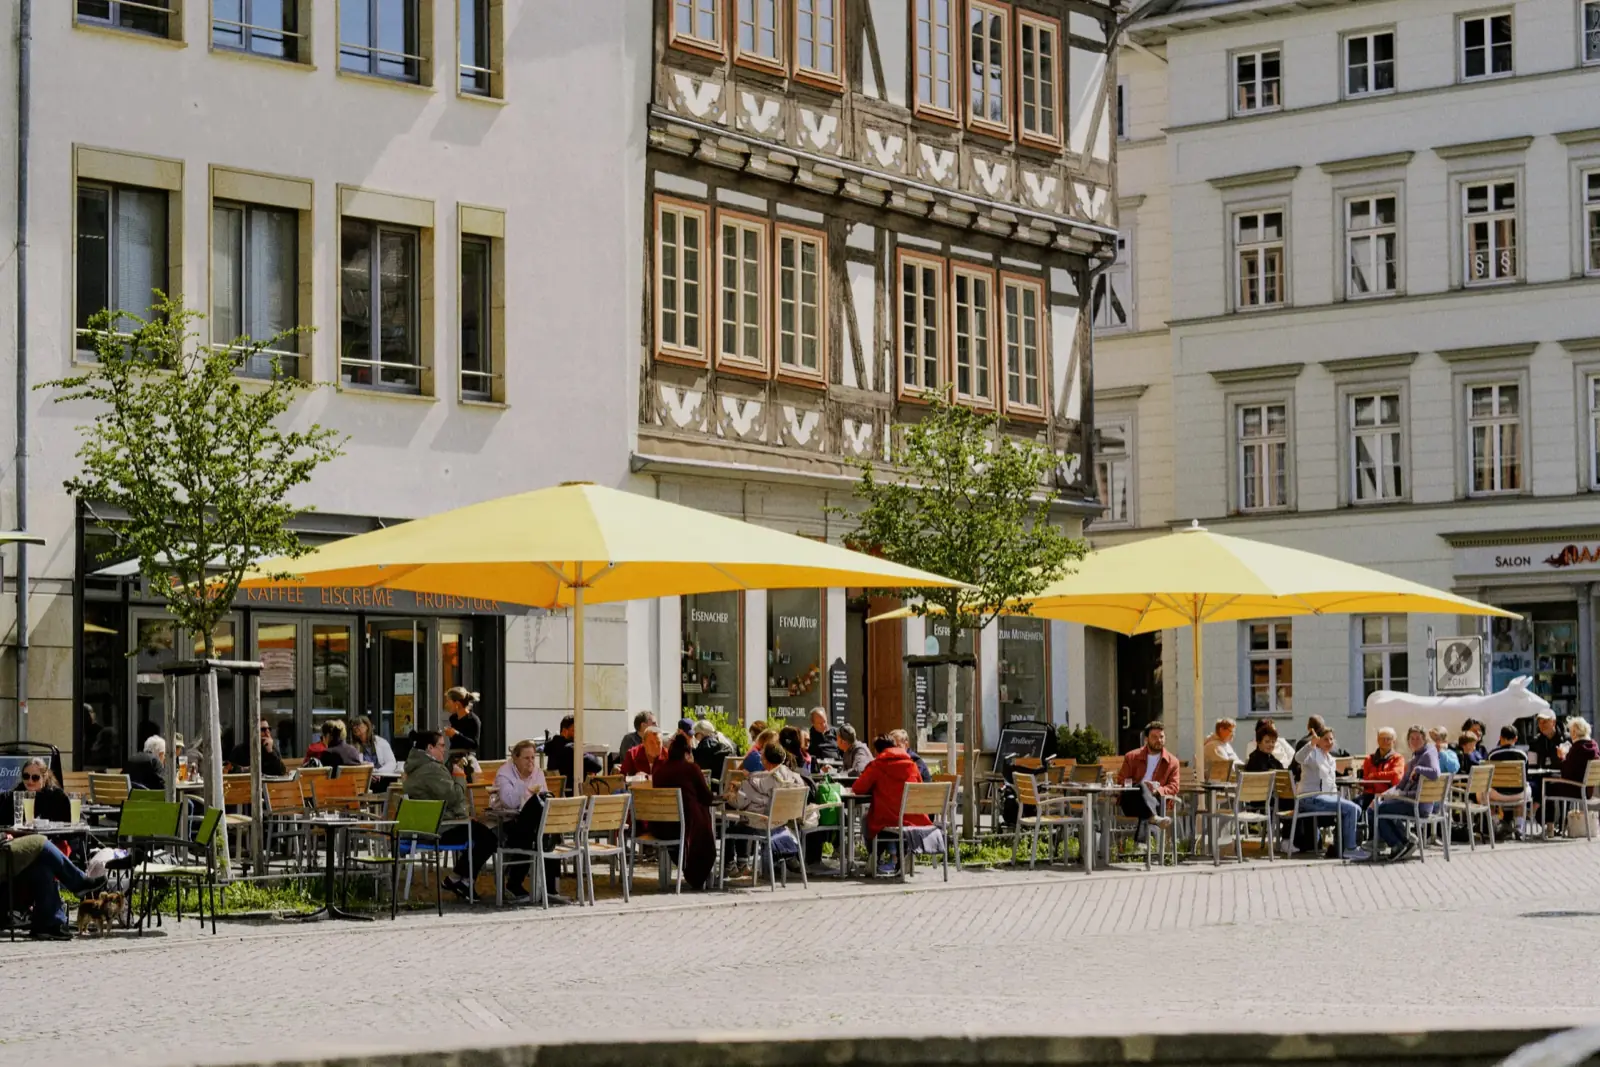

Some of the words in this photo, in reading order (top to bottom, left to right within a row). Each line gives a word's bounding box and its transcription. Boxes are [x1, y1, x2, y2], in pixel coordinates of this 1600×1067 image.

[1495, 556, 1531, 568] SALON
[247, 587, 304, 603] KAFFEE
[321, 587, 394, 607] EISCREME
[691, 608, 729, 623] EISENACHER
